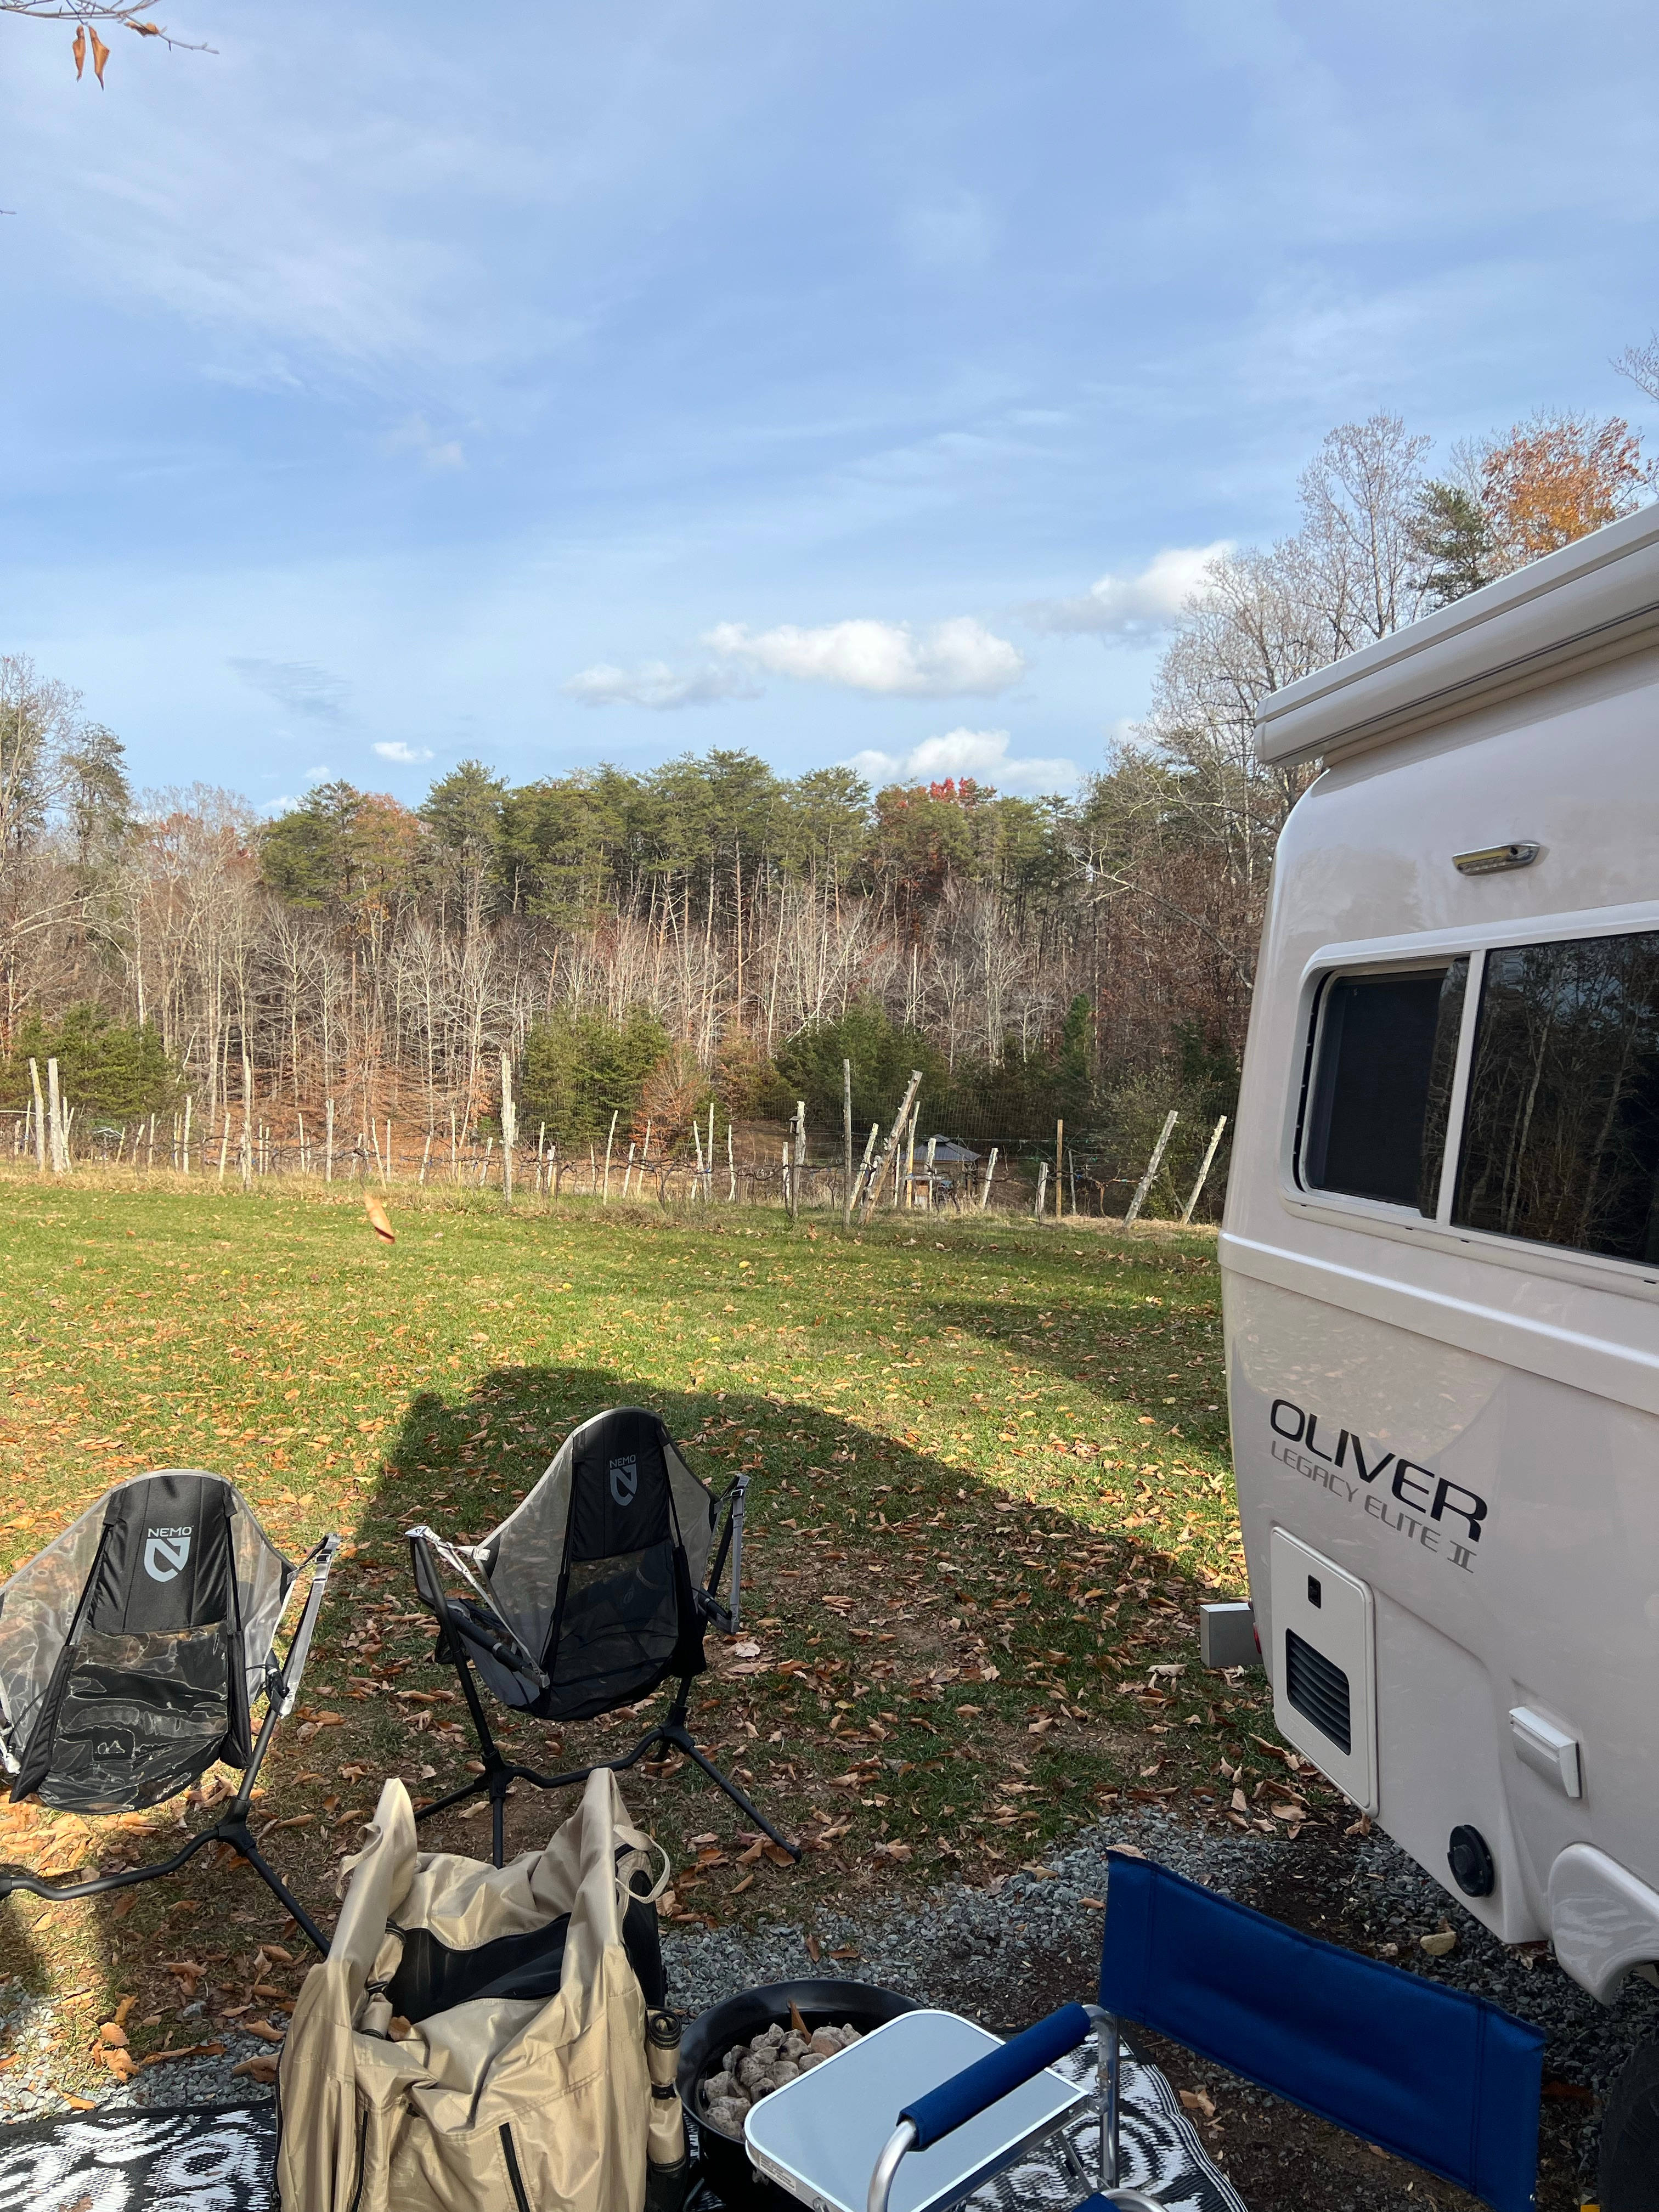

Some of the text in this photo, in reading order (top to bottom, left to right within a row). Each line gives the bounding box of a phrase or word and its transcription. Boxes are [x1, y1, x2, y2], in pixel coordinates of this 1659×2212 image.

[609, 1455, 636, 1469] NEMO
[1270, 1399, 1488, 1543] OLIVER
[148, 1526, 192, 1537] NEMO
[1271, 1440, 1477, 1573] LEGACY ELITE II
